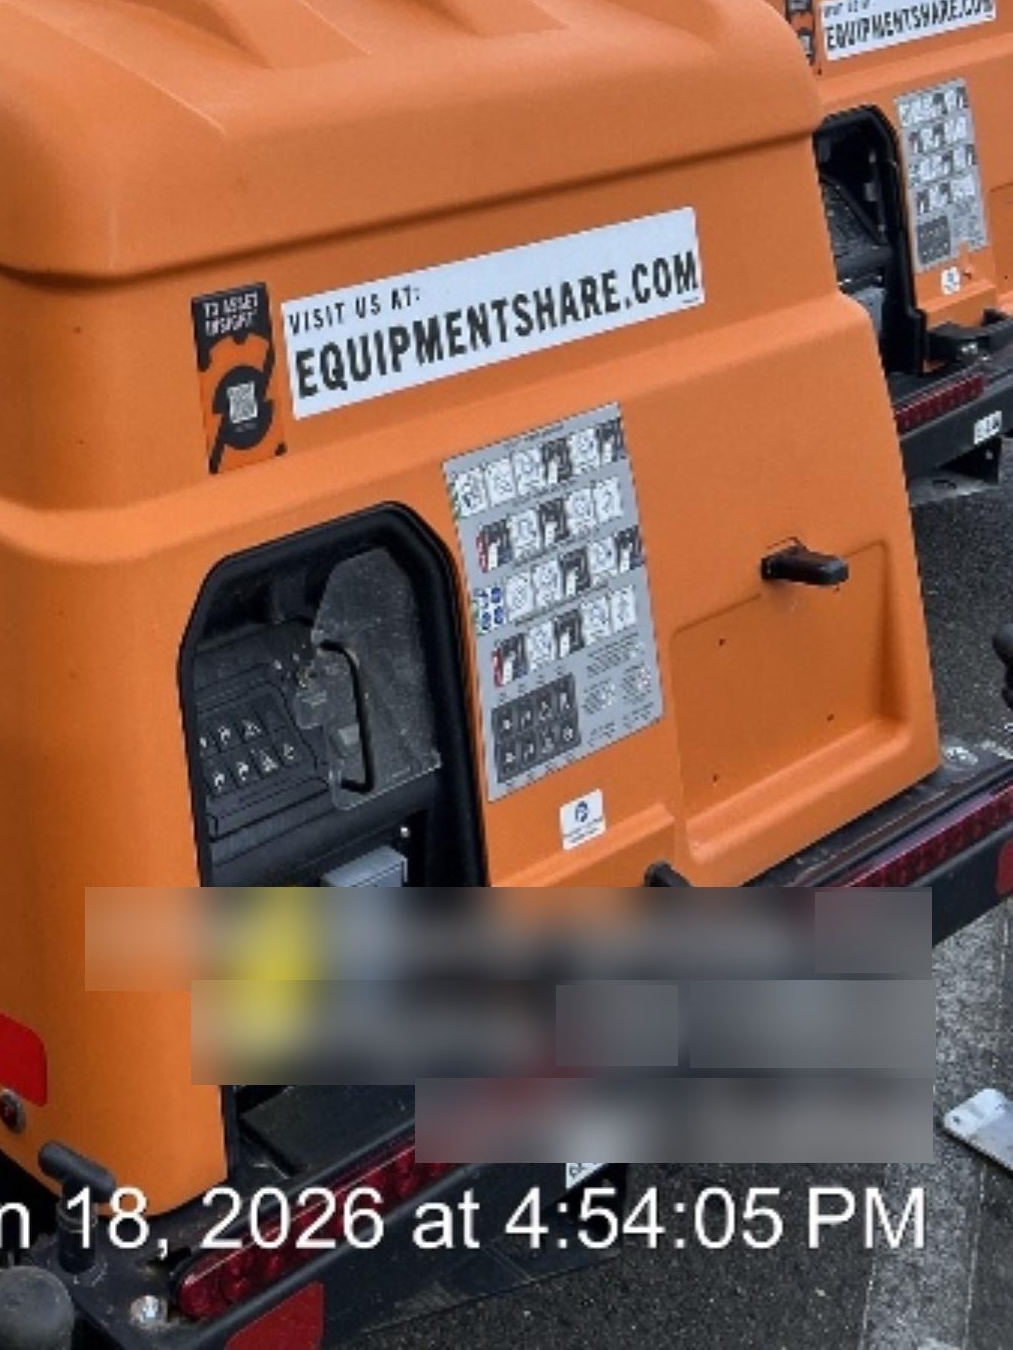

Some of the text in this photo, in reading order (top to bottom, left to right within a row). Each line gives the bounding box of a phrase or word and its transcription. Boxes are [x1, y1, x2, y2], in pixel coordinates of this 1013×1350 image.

[289, 284, 420, 335] VISIT US AT:
[295, 250, 699, 398] EQUIPMENTSHARE.COM
